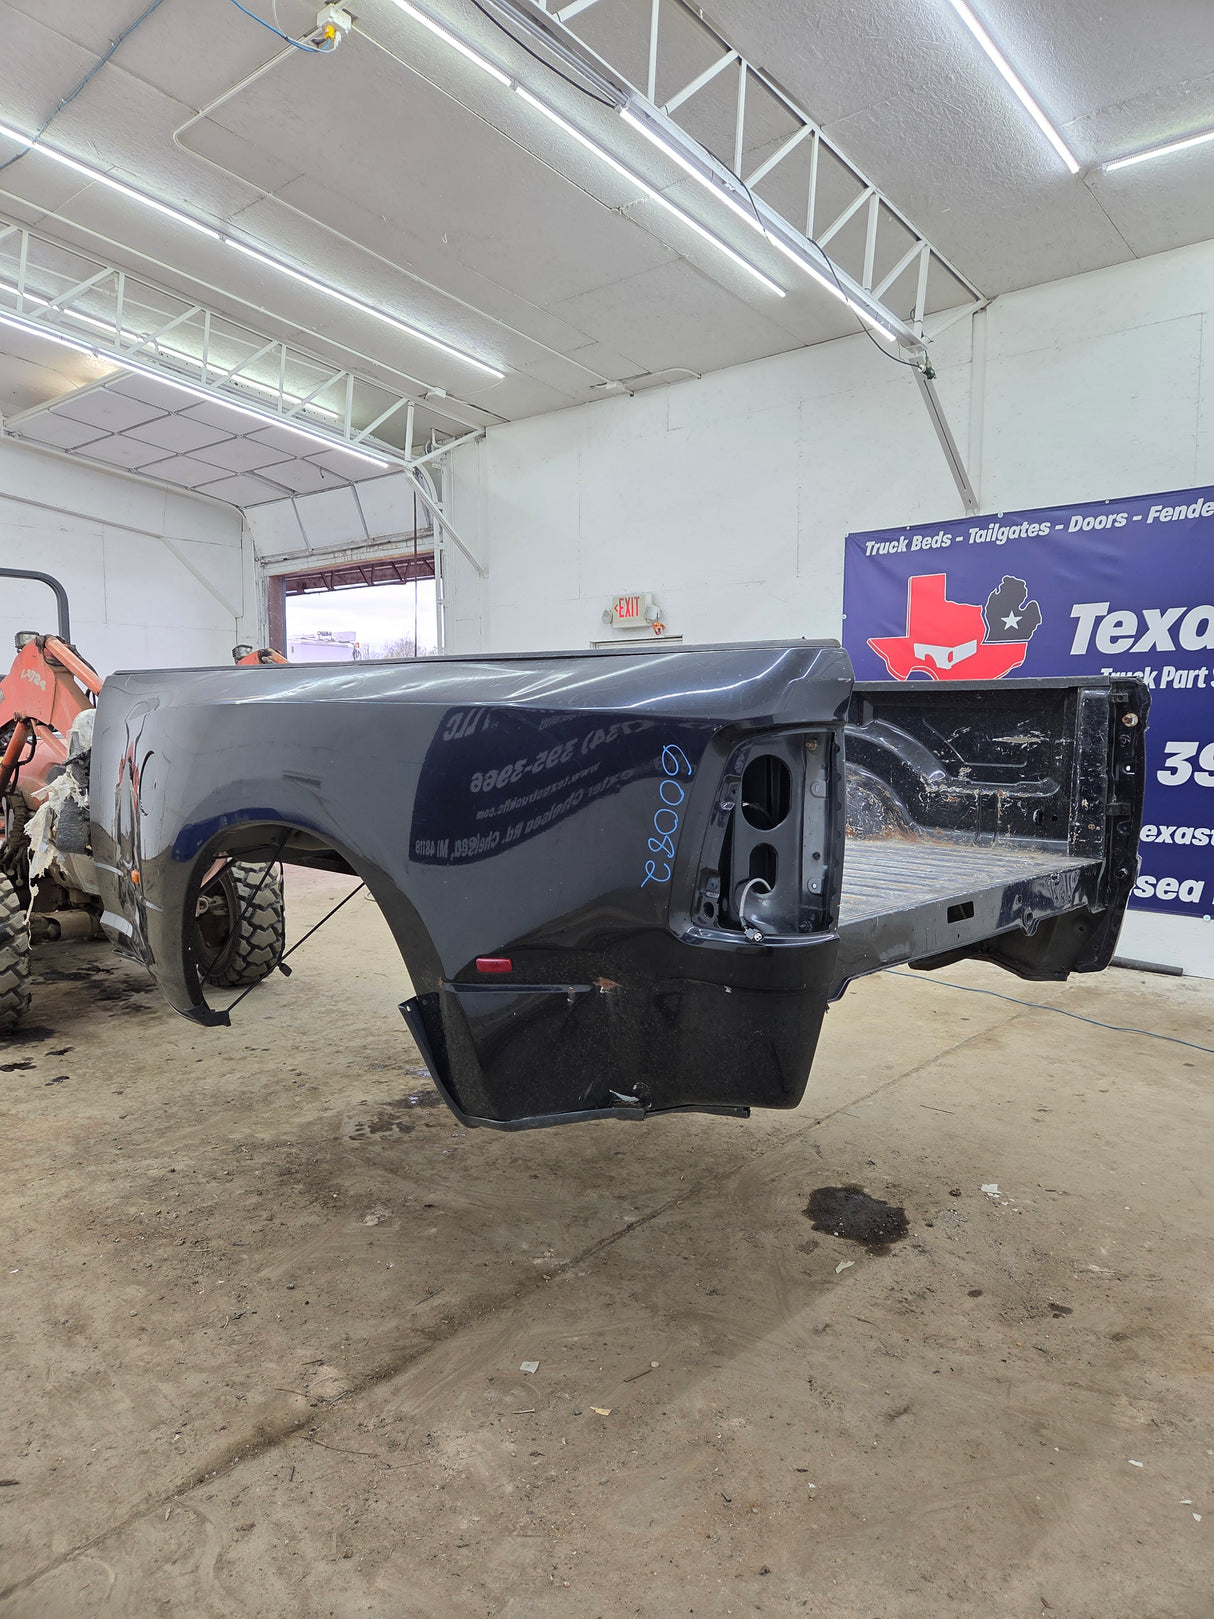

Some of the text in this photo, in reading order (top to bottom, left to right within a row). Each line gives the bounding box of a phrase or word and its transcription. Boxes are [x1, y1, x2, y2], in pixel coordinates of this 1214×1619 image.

[865, 536, 908, 556] Truck
[911, 531, 952, 551] Beds
[969, 521, 1050, 545] Tailgates
[1068, 510, 1128, 533] Doors
[618, 596, 640, 618] EXIT
[1070, 602, 1214, 655] Texa
[1160, 666, 1208, 689] Part
[1140, 824, 1214, 846] exas
